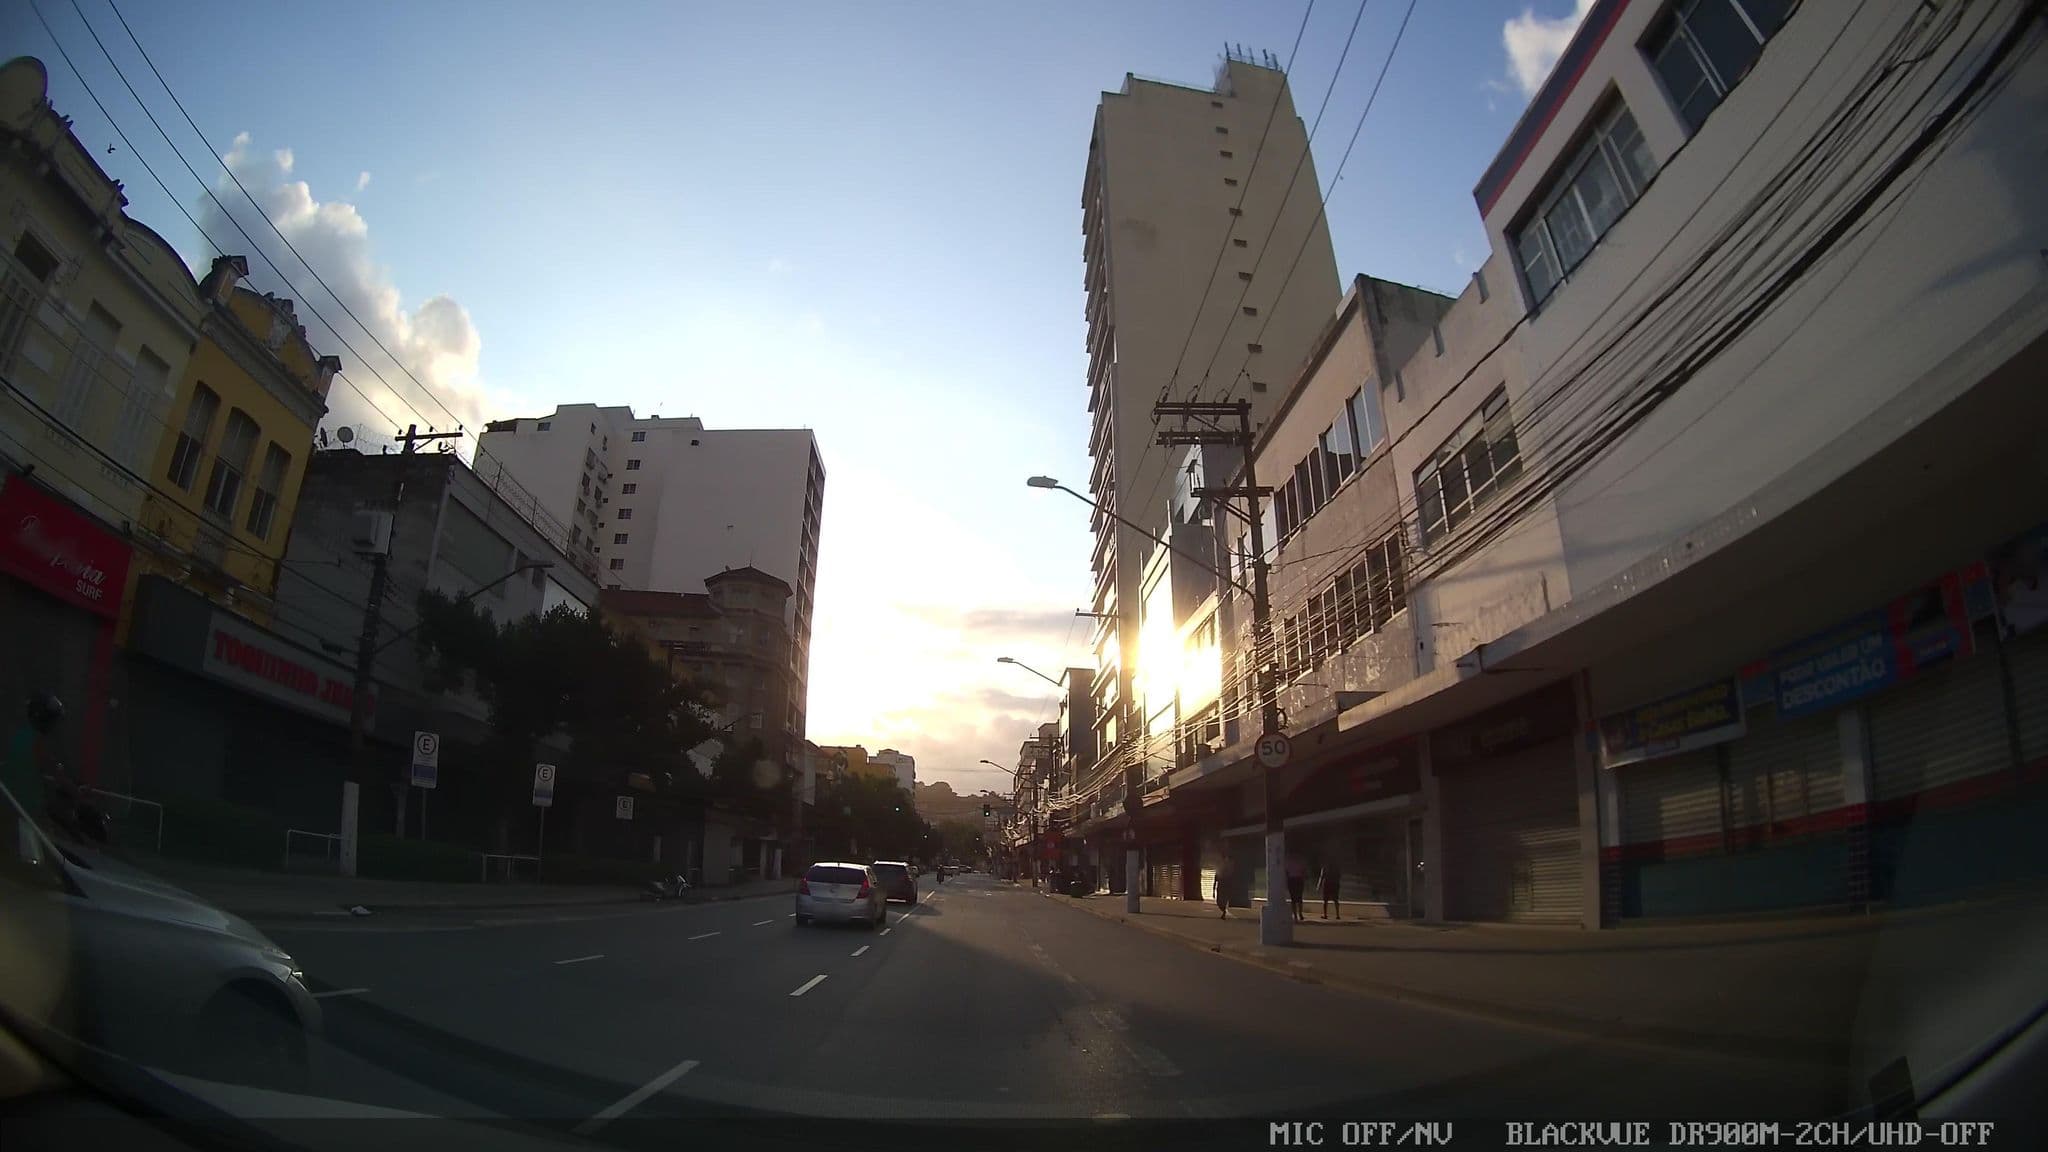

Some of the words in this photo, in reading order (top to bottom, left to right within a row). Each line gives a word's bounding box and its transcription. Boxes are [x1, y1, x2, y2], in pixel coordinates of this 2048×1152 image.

[76, 579, 103, 600] SURF
[422, 738, 431, 751] E
[1261, 739, 1286, 756] 50
